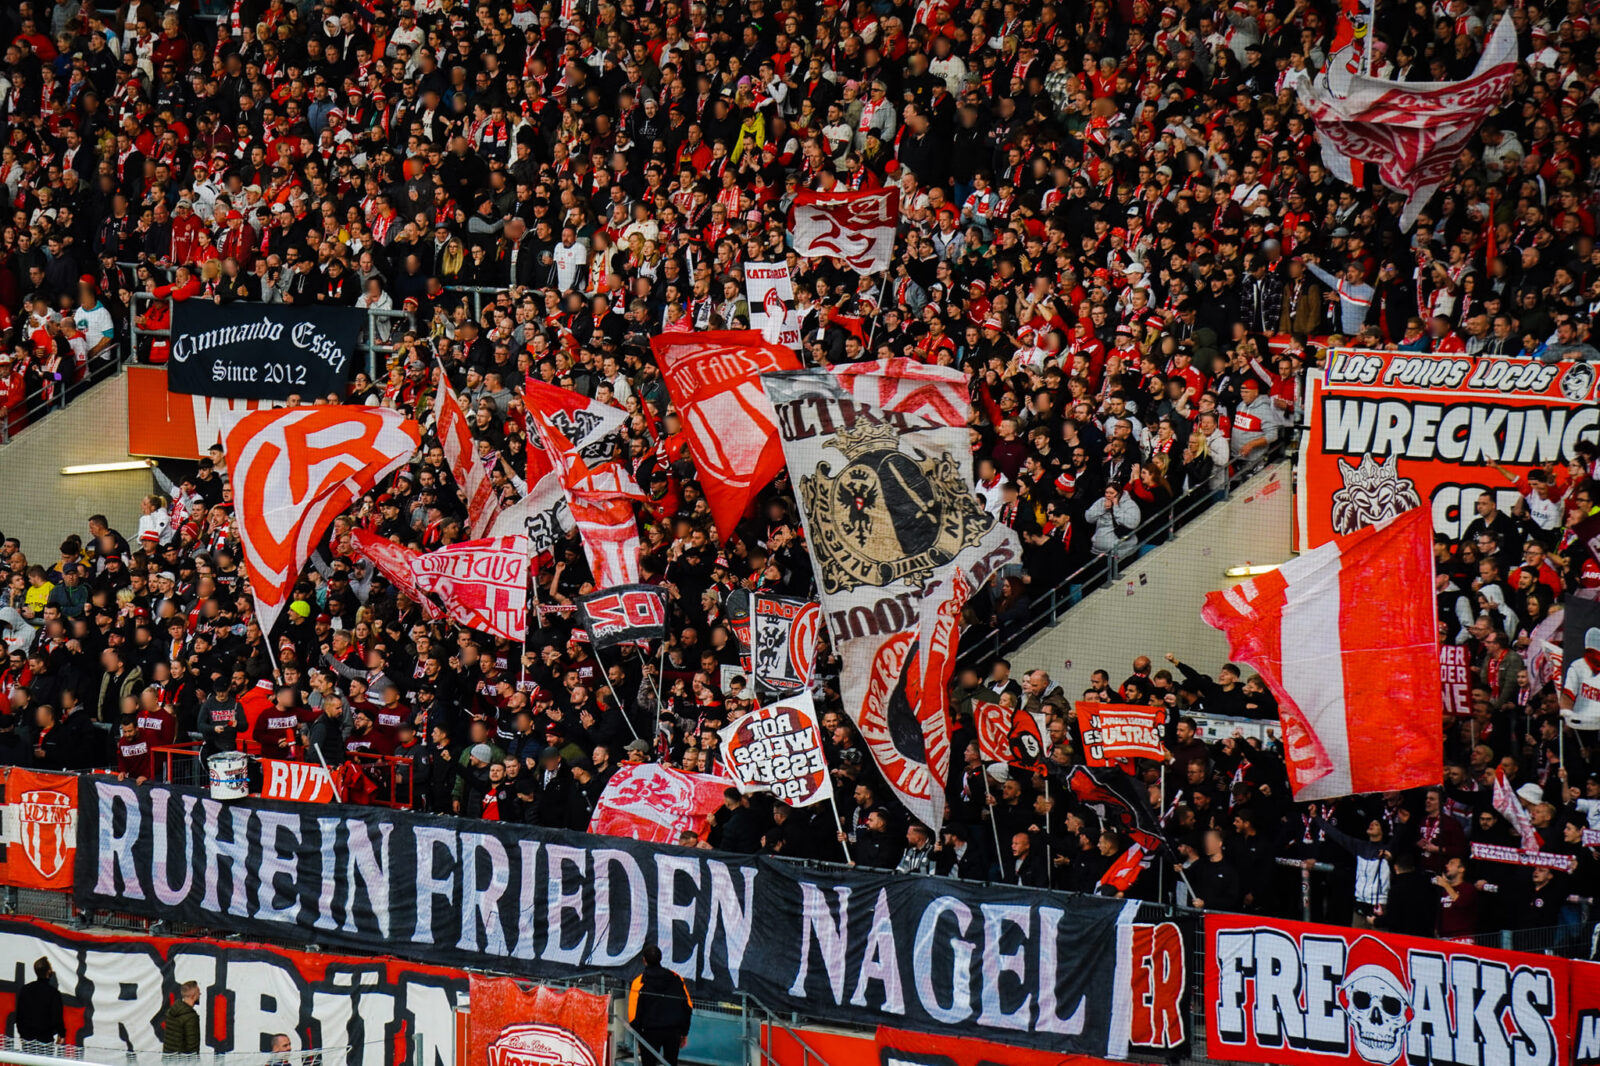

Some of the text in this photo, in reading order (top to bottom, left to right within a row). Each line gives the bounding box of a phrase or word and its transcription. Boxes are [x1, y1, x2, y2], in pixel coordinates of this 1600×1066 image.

[212, 359, 307, 385] Since 2012
[1330, 355, 1383, 384] LOS
[1469, 360, 1558, 391] LOCOS
[1325, 399, 1600, 462] WRECKING
[1102, 725, 1160, 747] ULTRAS
[268, 761, 328, 801] RVT
[94, 782, 1086, 1035] RUHE IN FRIEDEN NAGEL
[1216, 927, 1556, 1066] FREAKS
